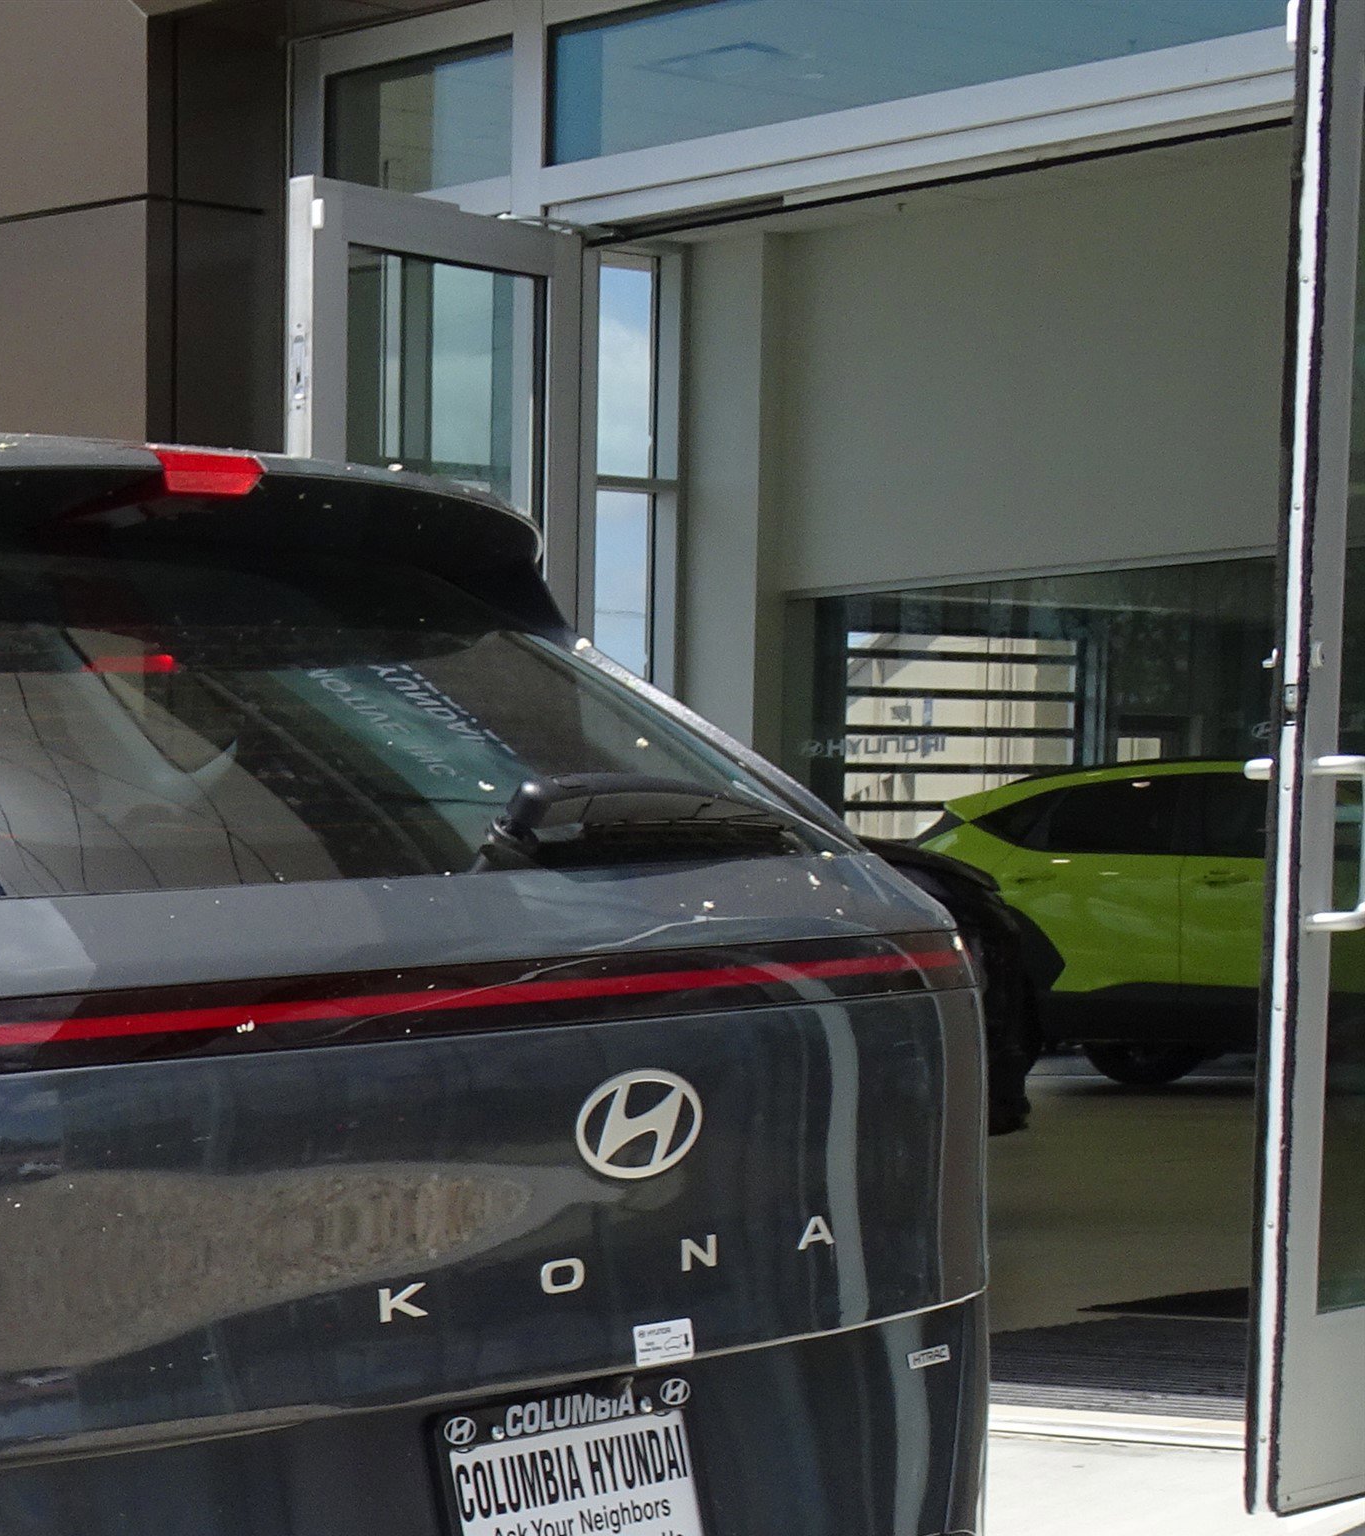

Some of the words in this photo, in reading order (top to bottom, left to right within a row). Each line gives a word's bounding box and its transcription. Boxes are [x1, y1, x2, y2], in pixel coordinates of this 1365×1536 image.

[827, 735, 946, 758] HYUNDAI
[378, 1215, 835, 1324] KONA
[505, 1391, 635, 1437] COLUMBIA
[455, 1444, 586, 1523] COLUMBIA
[585, 1425, 688, 1496] HYUNDAI
[579, 1498, 671, 1534] Neighbors
